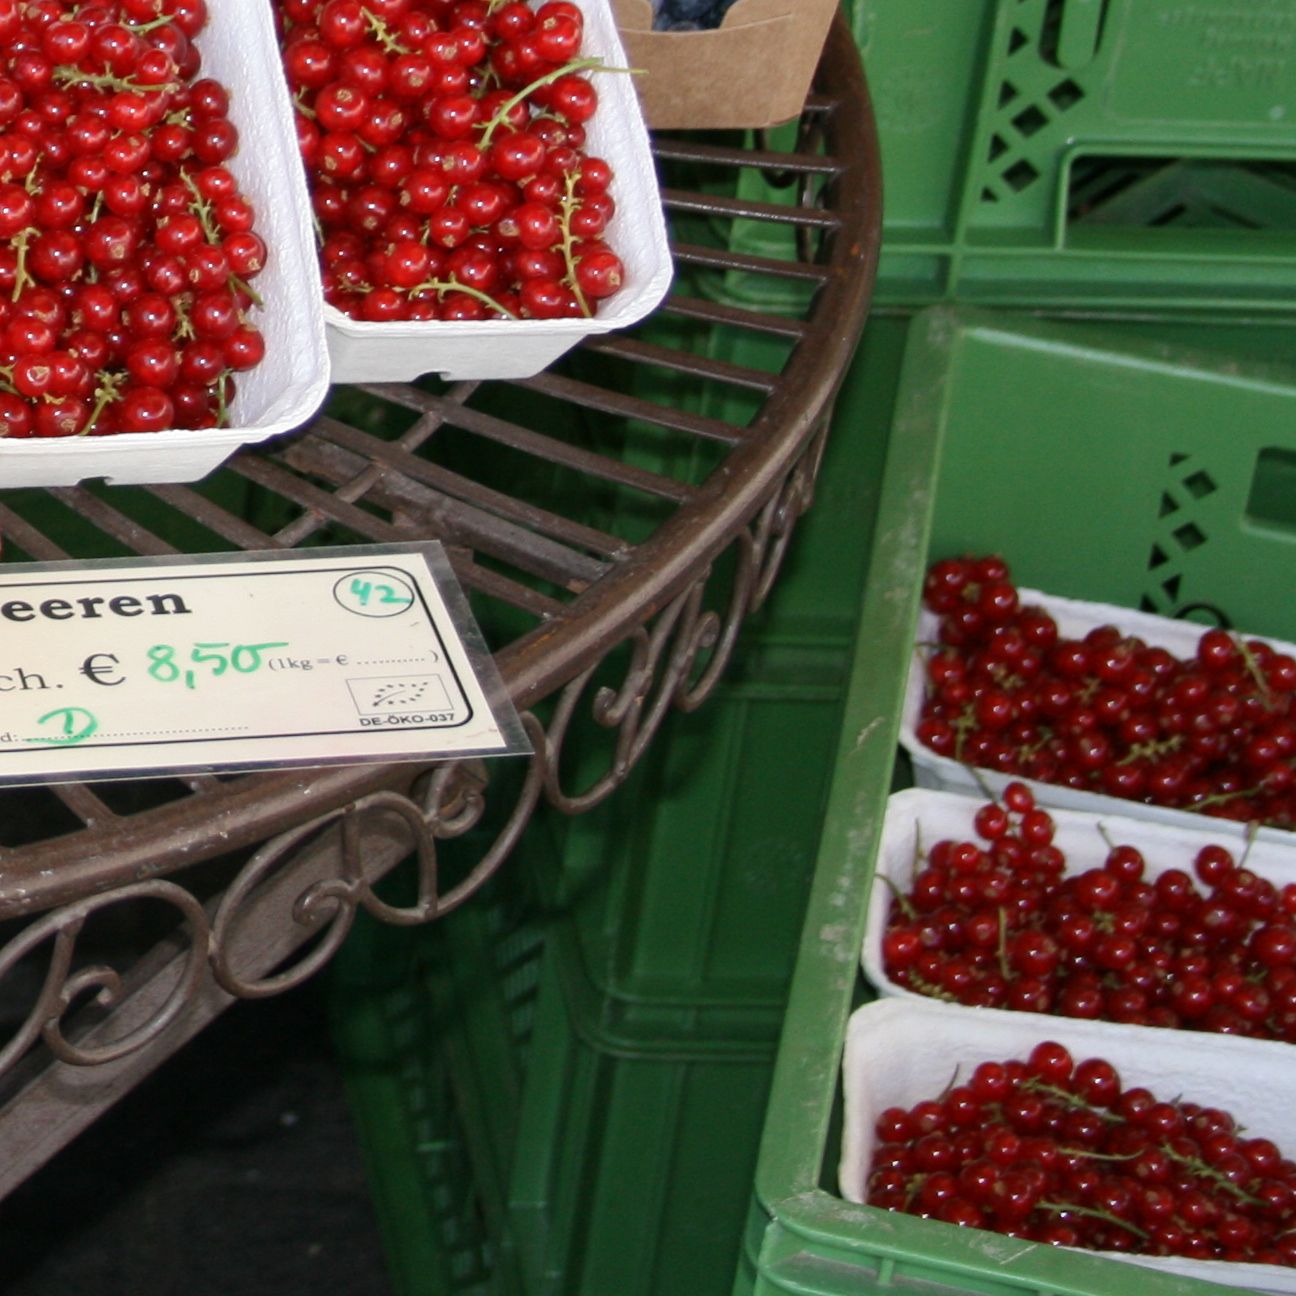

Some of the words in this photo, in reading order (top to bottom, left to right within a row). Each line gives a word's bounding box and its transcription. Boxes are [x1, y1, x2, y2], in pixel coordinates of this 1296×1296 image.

[350, 577, 413, 606] 42
[79, 654, 127, 686] €
[147, 643, 289, 689] 8,50
[359, 713, 455, 727] DE-ÖKO-037
